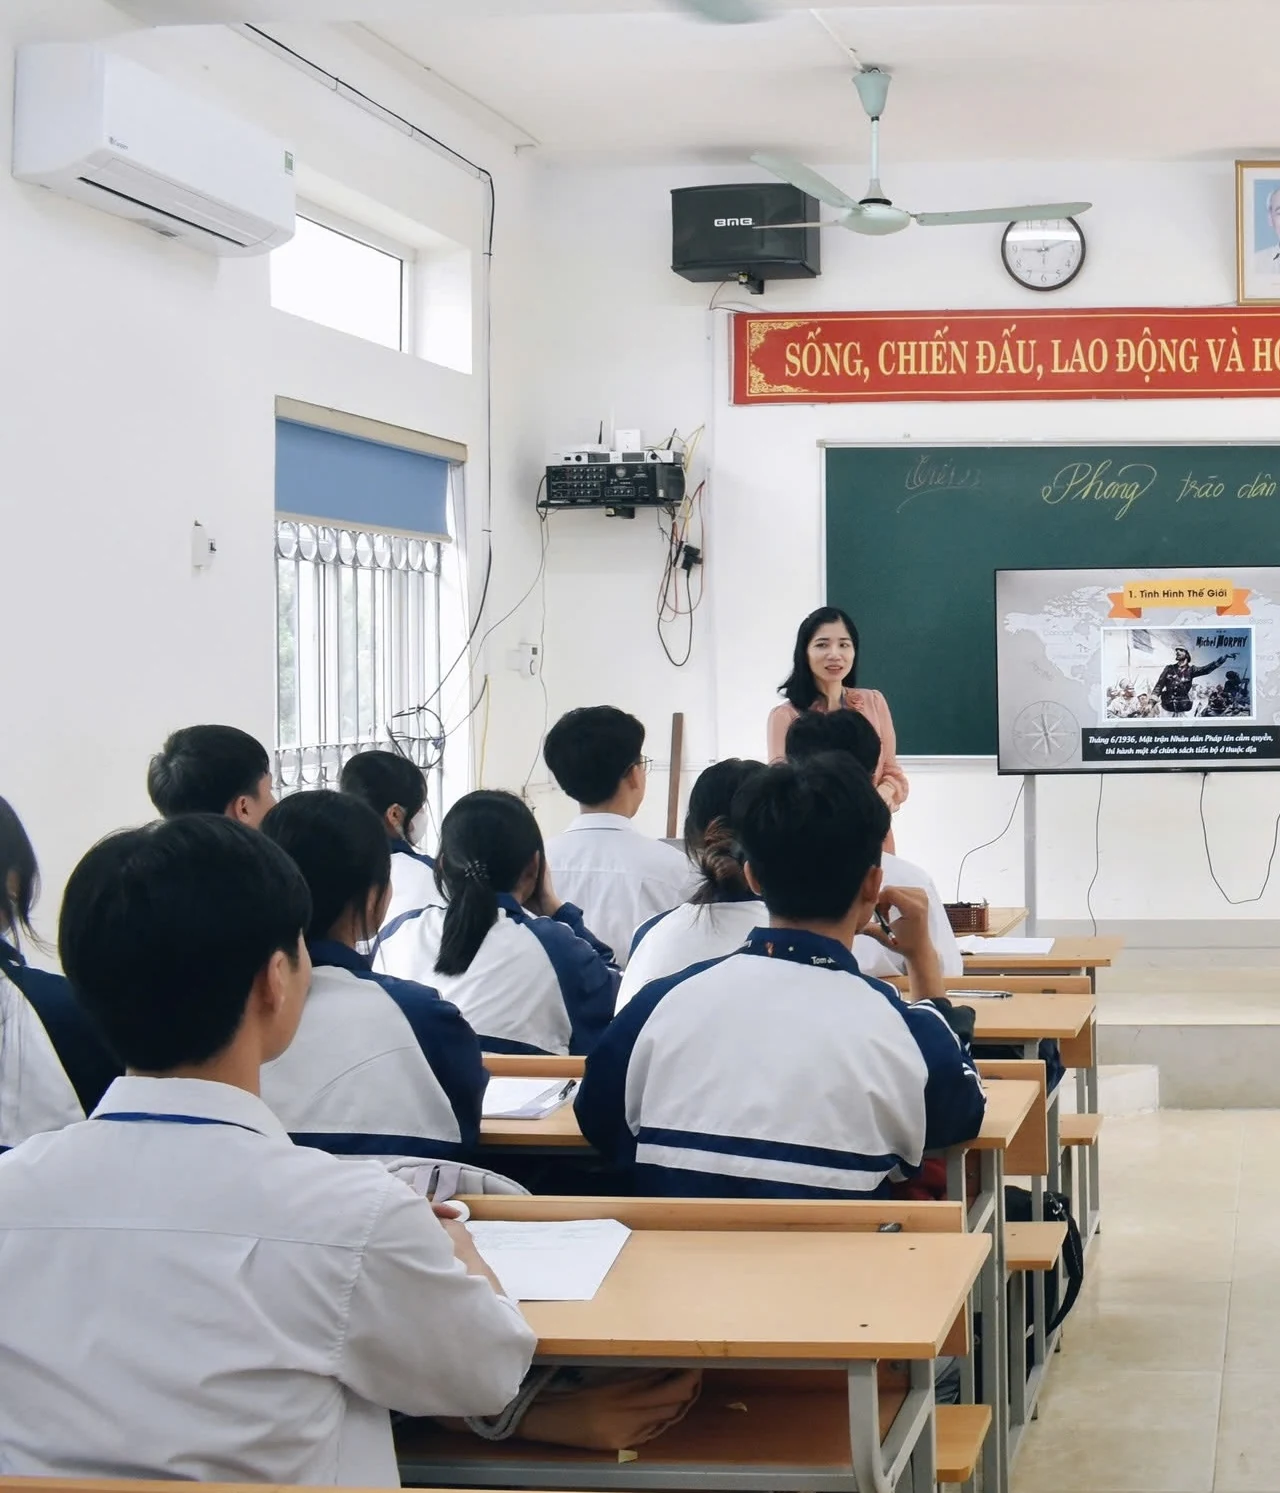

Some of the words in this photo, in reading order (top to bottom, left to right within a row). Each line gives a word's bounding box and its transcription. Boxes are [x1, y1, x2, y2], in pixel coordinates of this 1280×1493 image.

[785, 327, 870, 382] SỐNG,
[878, 326, 969, 376] CHIẾN
[976, 324, 1044, 380] ĐẤU,
[1051, 338, 1109, 374] LAO
[1116, 326, 1200, 383] ĐỘNG
[1206, 326, 1245, 373] VÀ
[1237, 471, 1277, 498] dân
[1187, 588, 1205, 597] Thế
[1089, 736, 1109, 744] Tháng
[1110, 736, 1137, 744] 6/1936,
[1205, 734, 1222, 743] Pháp
[811, 956, 827, 965] Tom
